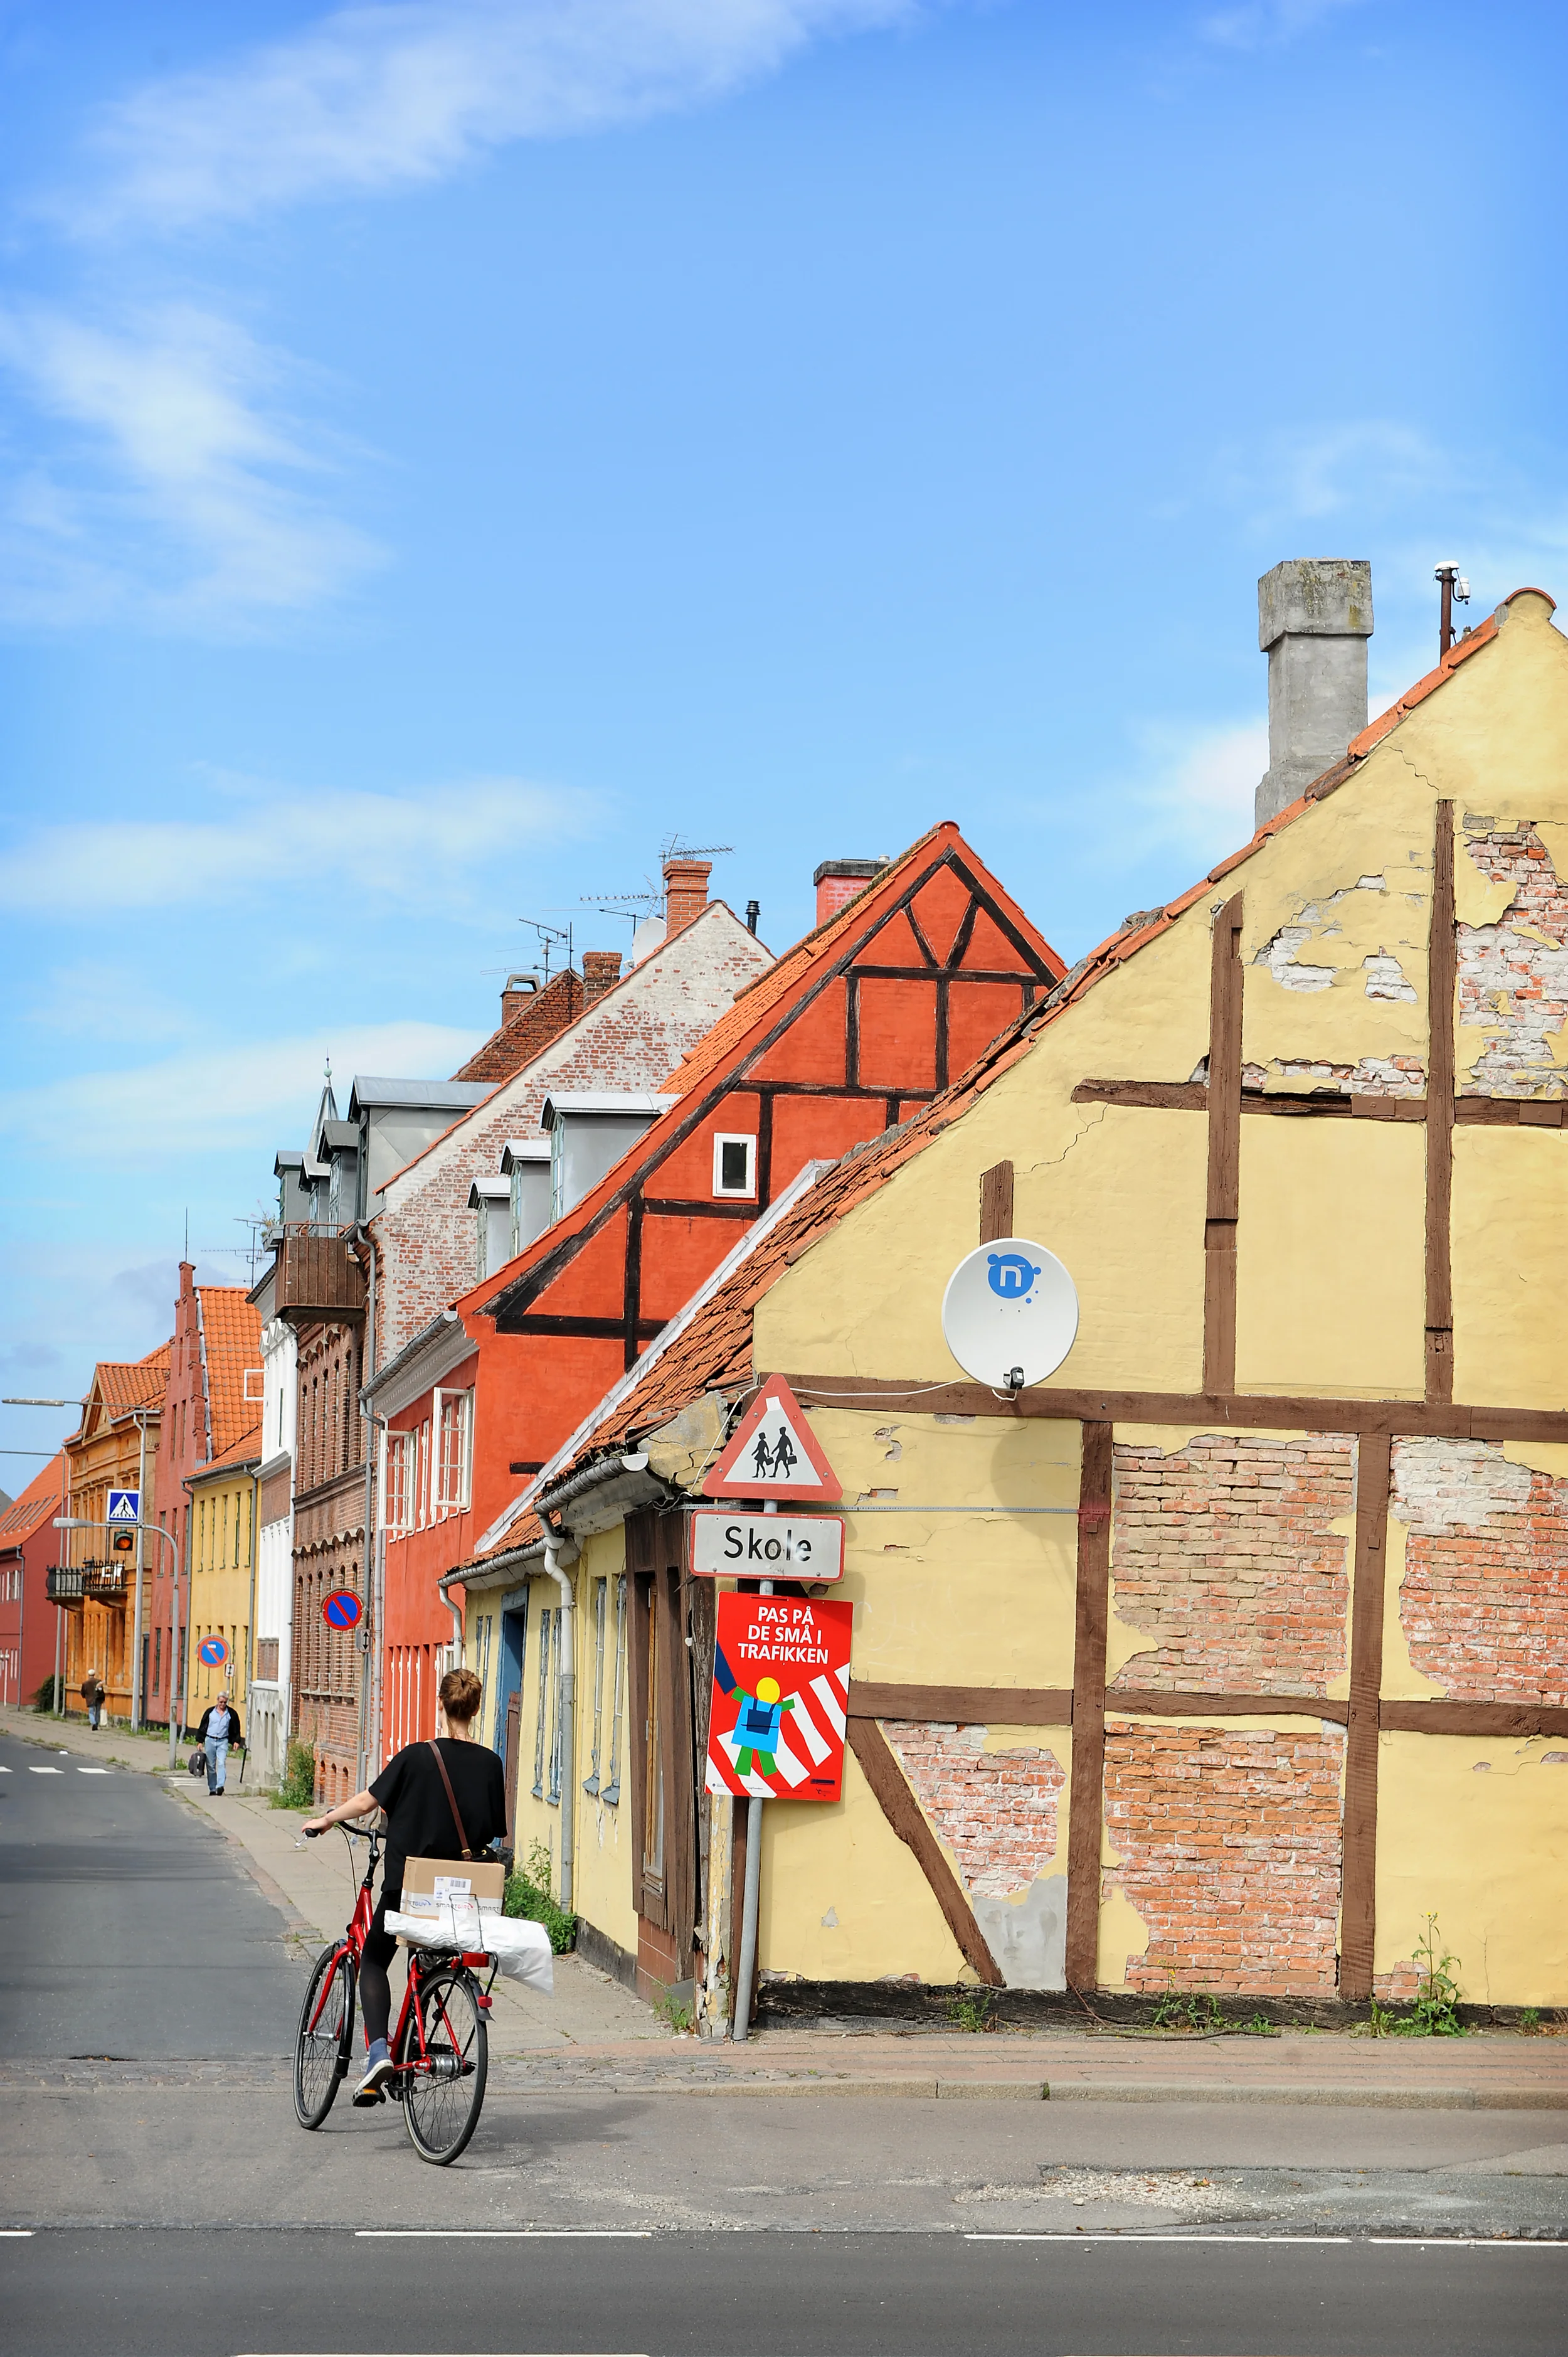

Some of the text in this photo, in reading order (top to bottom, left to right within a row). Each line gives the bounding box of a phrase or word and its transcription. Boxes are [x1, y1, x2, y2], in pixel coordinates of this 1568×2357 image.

[723, 1526, 812, 1562] Skole
[758, 1605, 815, 1625] PAS PÅ
[748, 1624, 822, 1645] DE SMÅ I
[738, 1642, 829, 1664] TRAFIKKEN
